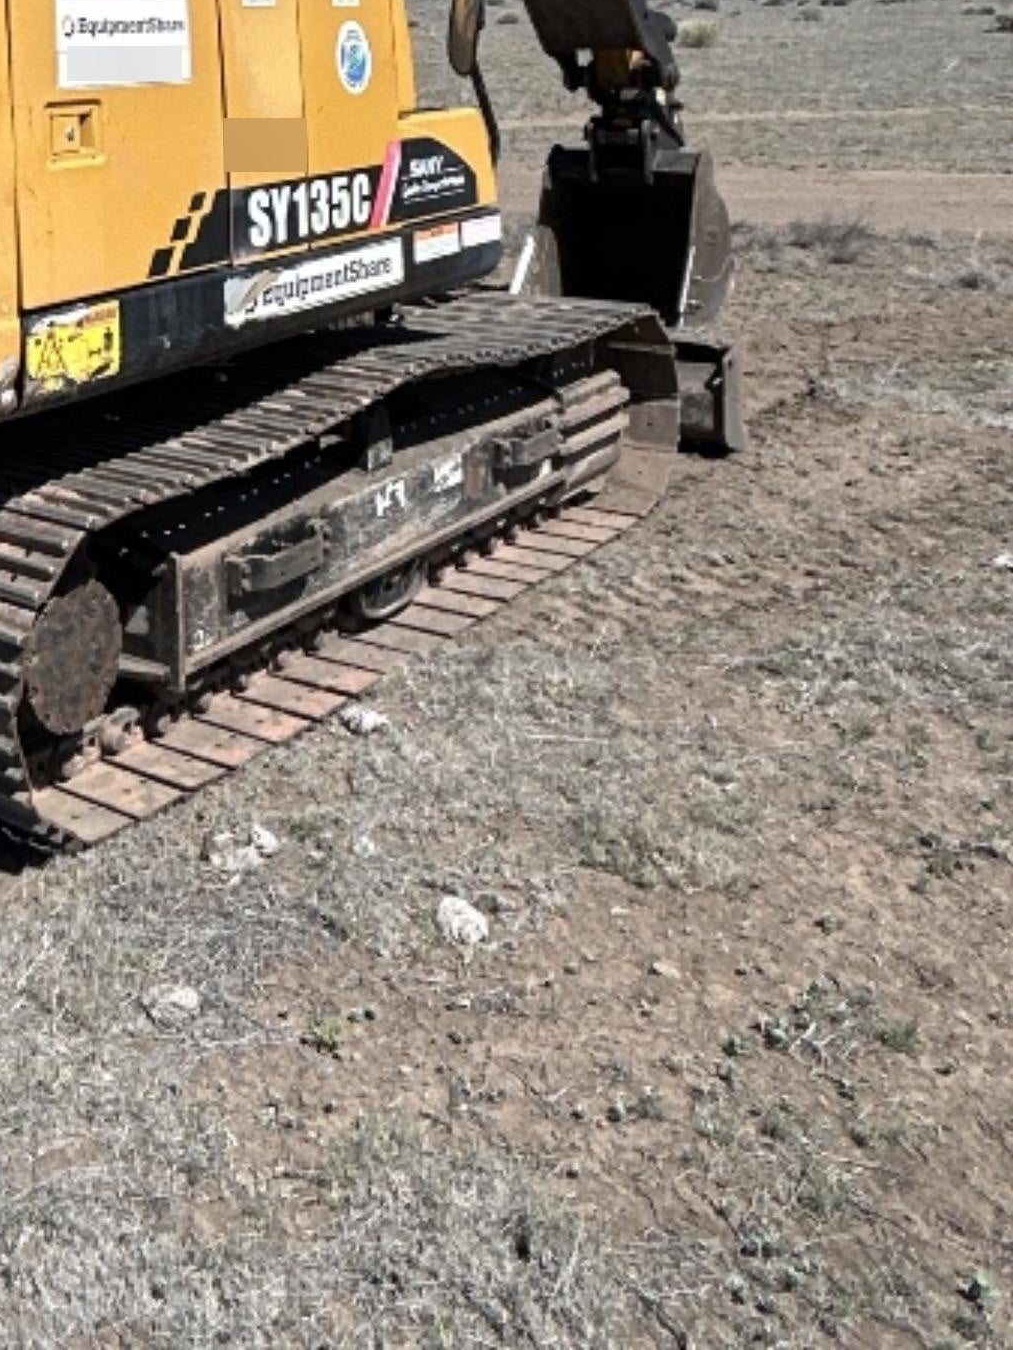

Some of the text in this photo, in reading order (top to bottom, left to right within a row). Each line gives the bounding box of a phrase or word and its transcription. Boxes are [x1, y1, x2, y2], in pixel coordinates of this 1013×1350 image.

[76, 16, 185, 39] EquipmentShare
[246, 172, 372, 248] SY135C
[261, 256, 392, 308] EquipmentShare
